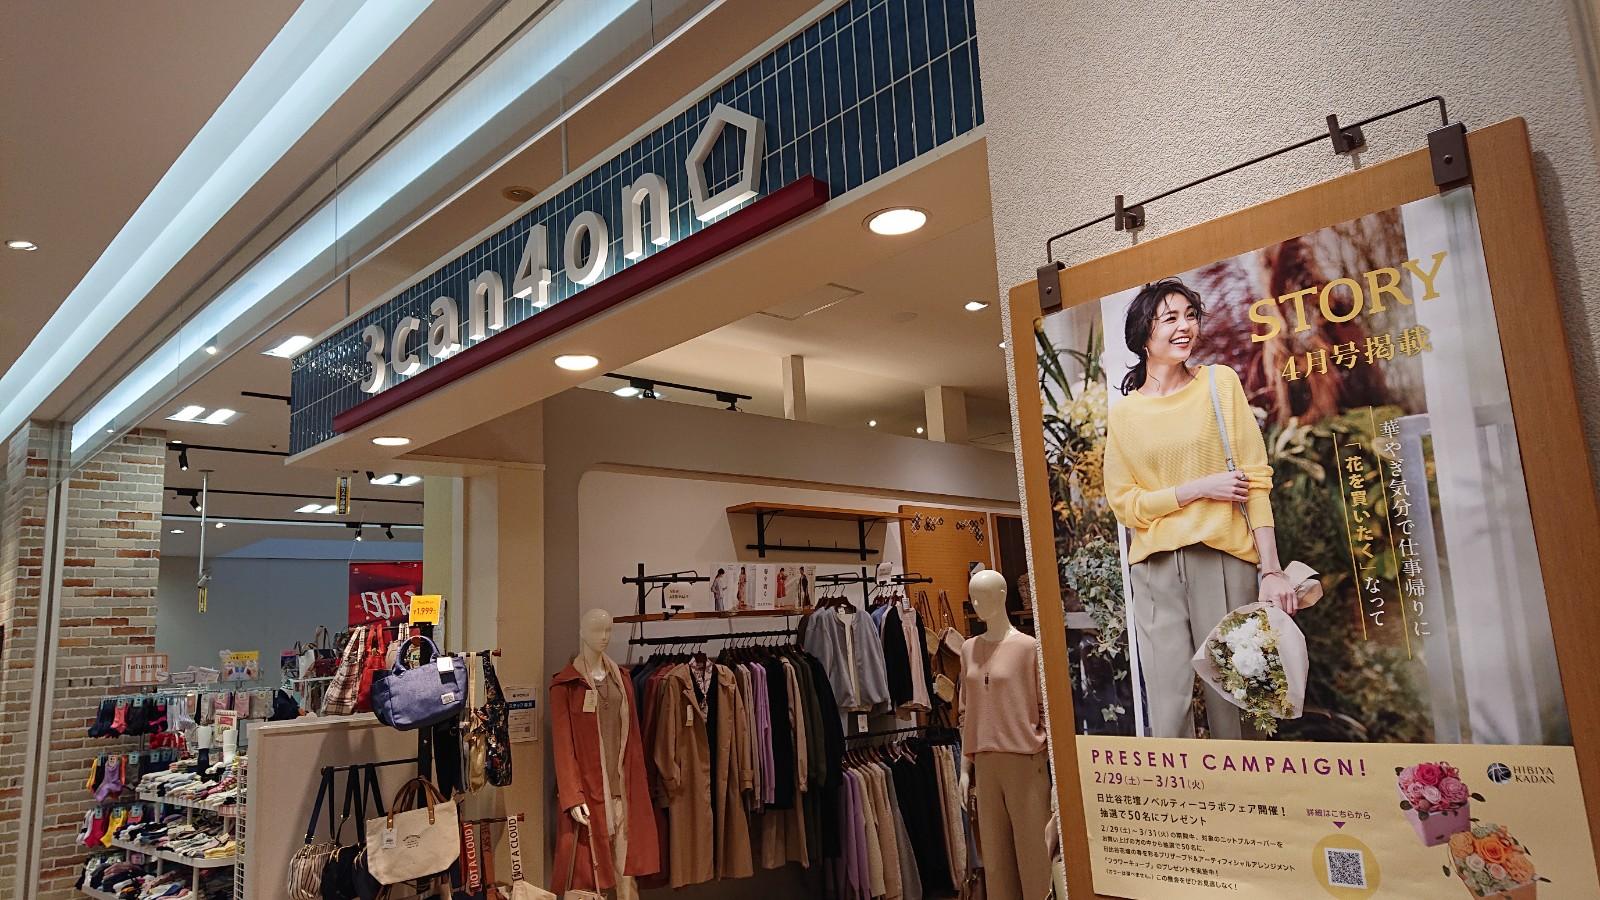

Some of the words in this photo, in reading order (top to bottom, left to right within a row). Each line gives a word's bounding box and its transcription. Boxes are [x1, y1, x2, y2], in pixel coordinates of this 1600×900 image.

[360, 172, 670, 394] 3can4on
[1249, 251, 1449, 343] STORY
[1281, 324, 1432, 382] 4月号掲載
[1380, 420, 1431, 637] 華やぎ気分で仕事帰りに
[1091, 749, 1188, 769] PRESENT
[1202, 754, 1366, 777] CAMPAIGN!
[1513, 766, 1554, 775] HIBIYA
[1515, 775, 1555, 784] KADAN
[1099, 808, 1207, 826] 抽選で50名にプレゼント
[1306, 808, 1371, 820] 詳細はこちらから
[464, 829, 476, 859] CLOUD
[508, 818, 518, 848] CLOUD
